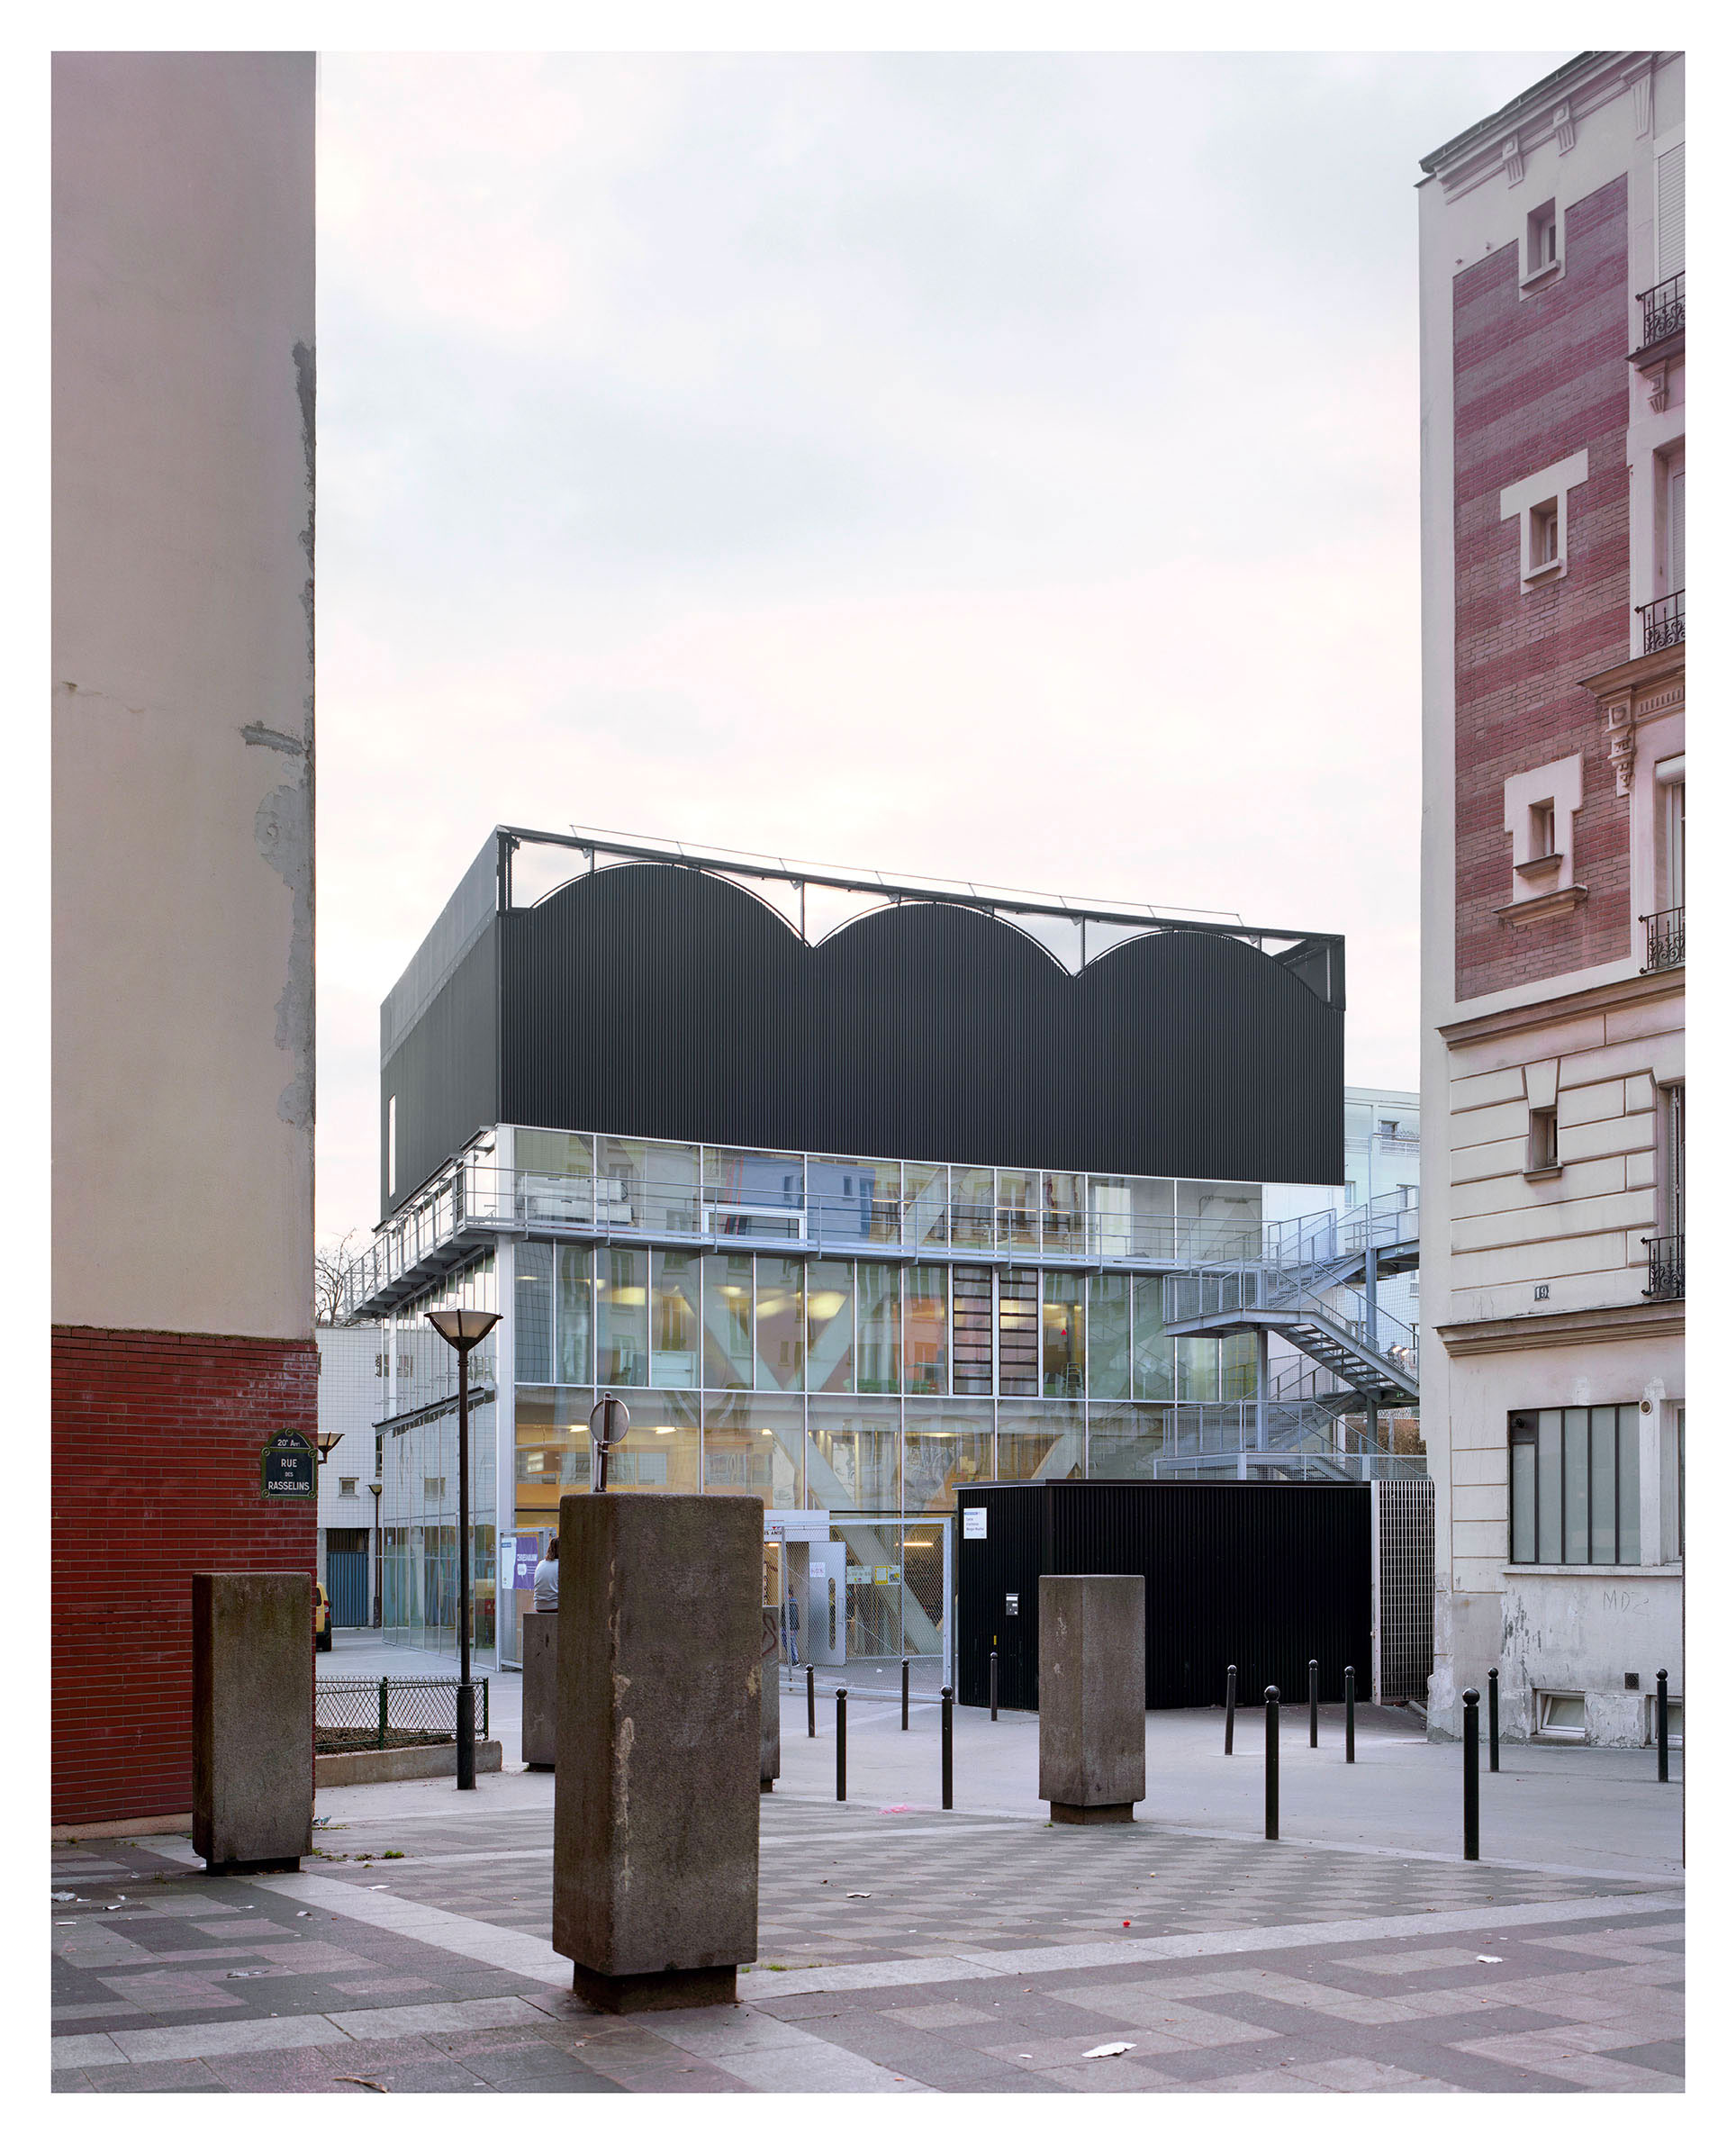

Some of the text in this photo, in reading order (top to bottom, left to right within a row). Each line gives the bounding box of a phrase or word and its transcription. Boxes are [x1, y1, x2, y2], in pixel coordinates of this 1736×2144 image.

[1536, 1287, 1547, 1298] 19
[281, 1459, 297, 1468] RUE
[268, 1481, 310, 1490] RASSELINS
